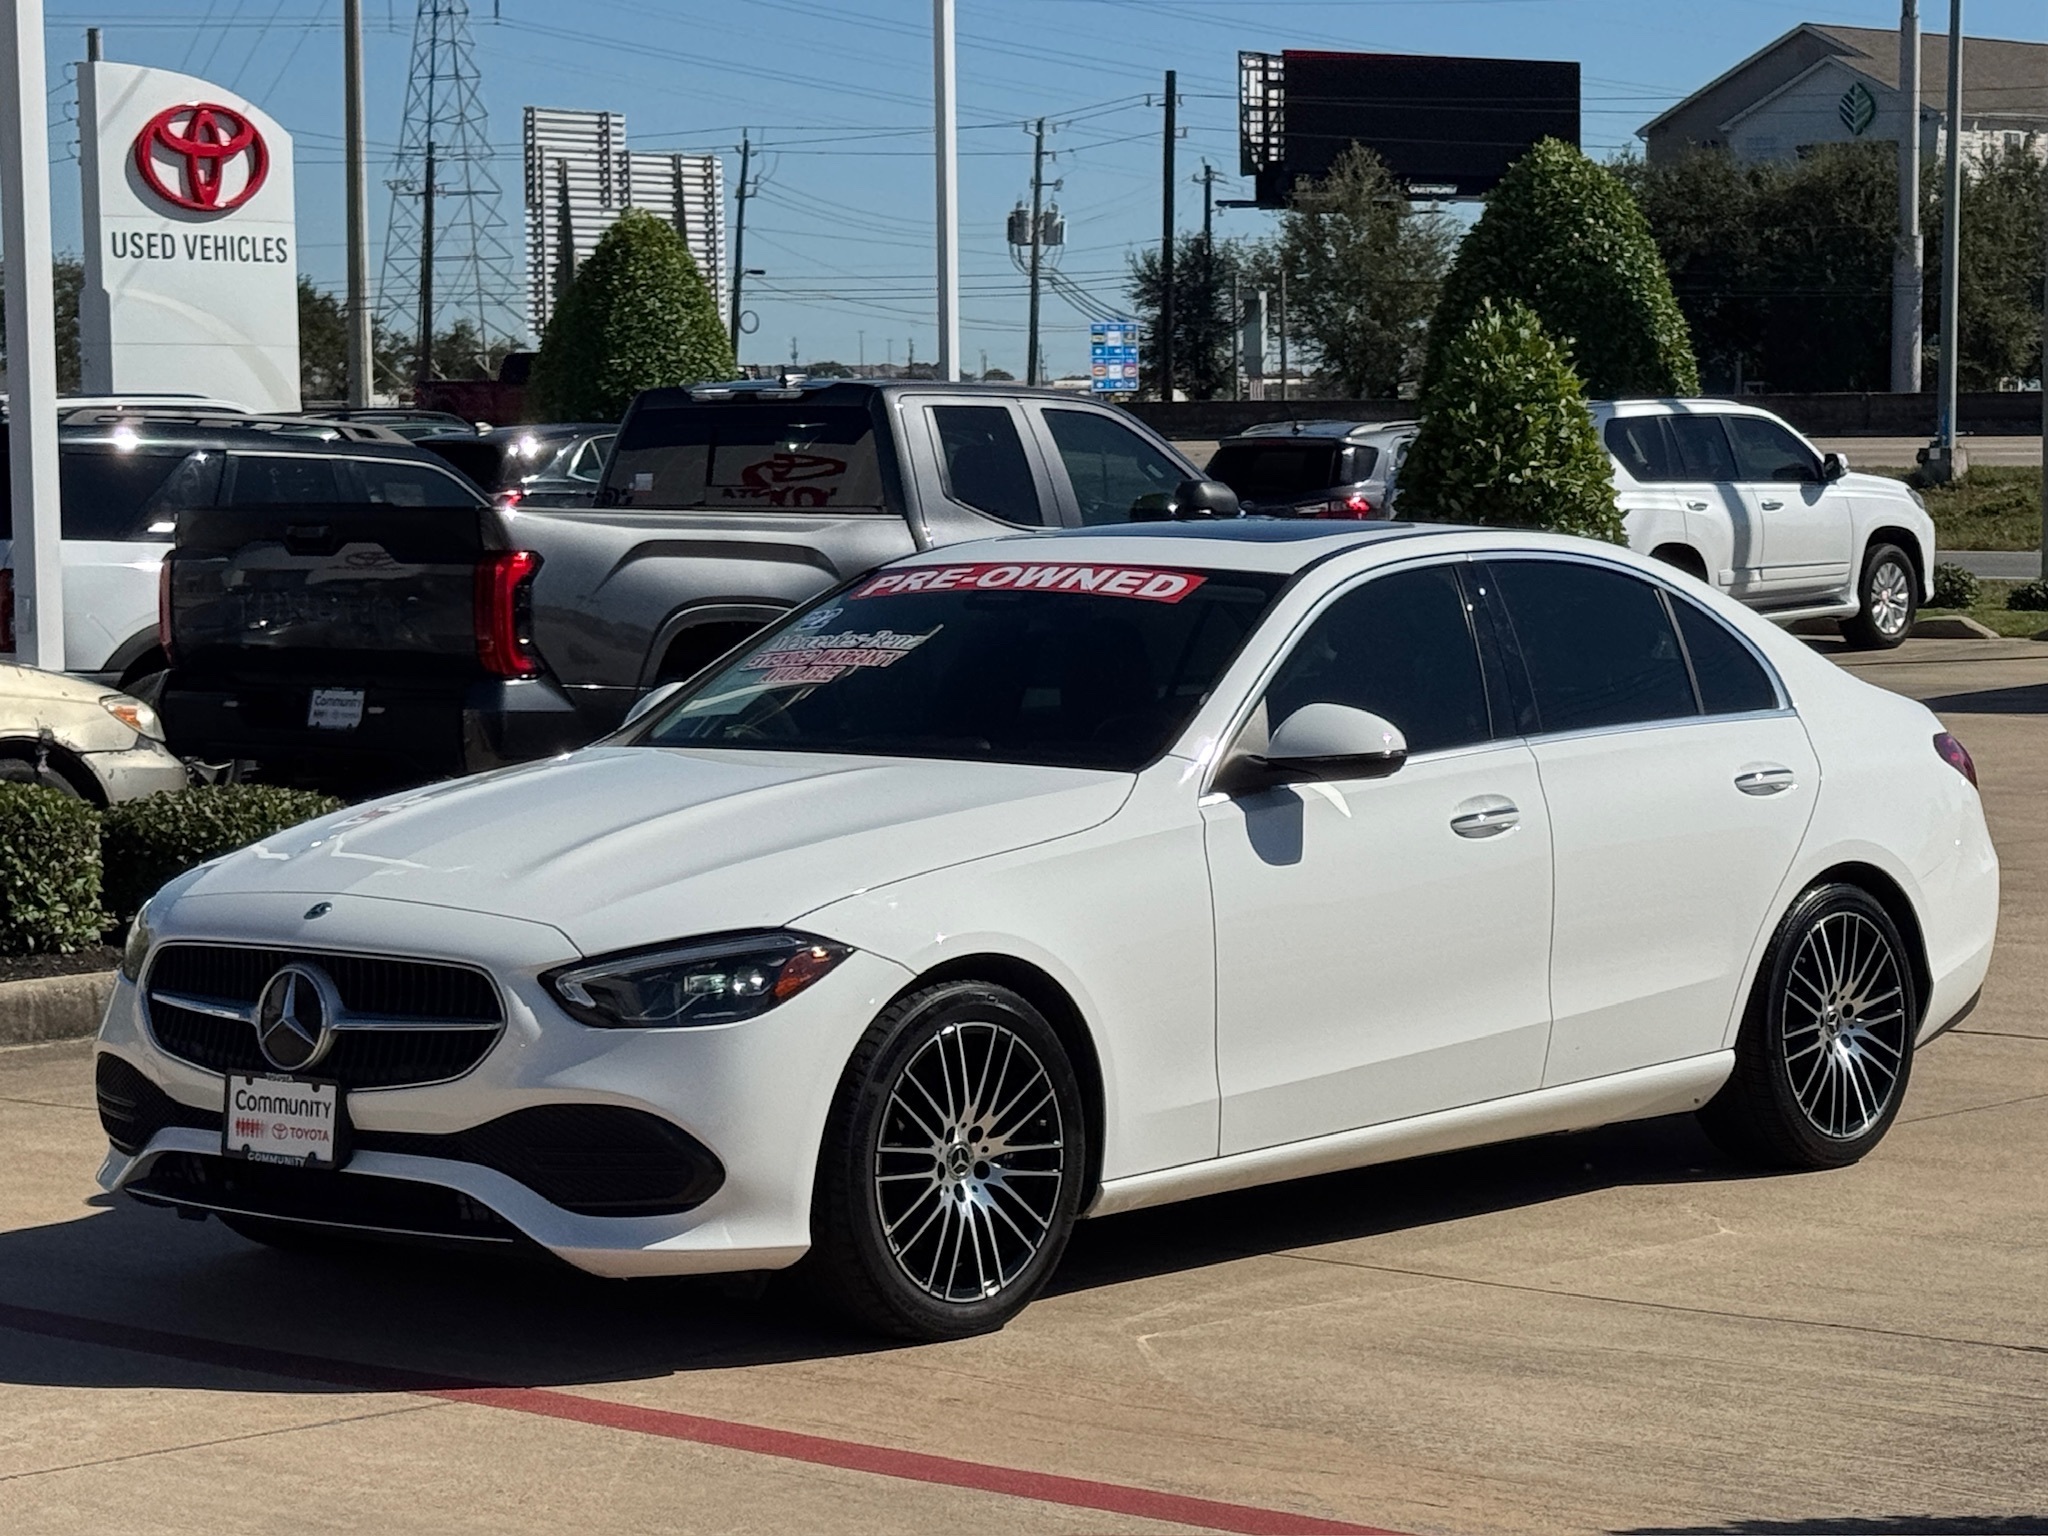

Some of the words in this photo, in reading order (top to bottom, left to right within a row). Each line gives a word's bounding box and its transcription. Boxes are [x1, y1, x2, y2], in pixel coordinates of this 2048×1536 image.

[112, 232, 176, 260] USED
[183, 234, 288, 263] VEHICLES
[857, 566, 1189, 598] PRE-OWNED
[290, 1127, 330, 1142] TOYOTA
[247, 1151, 306, 1167] COMMUNITY
